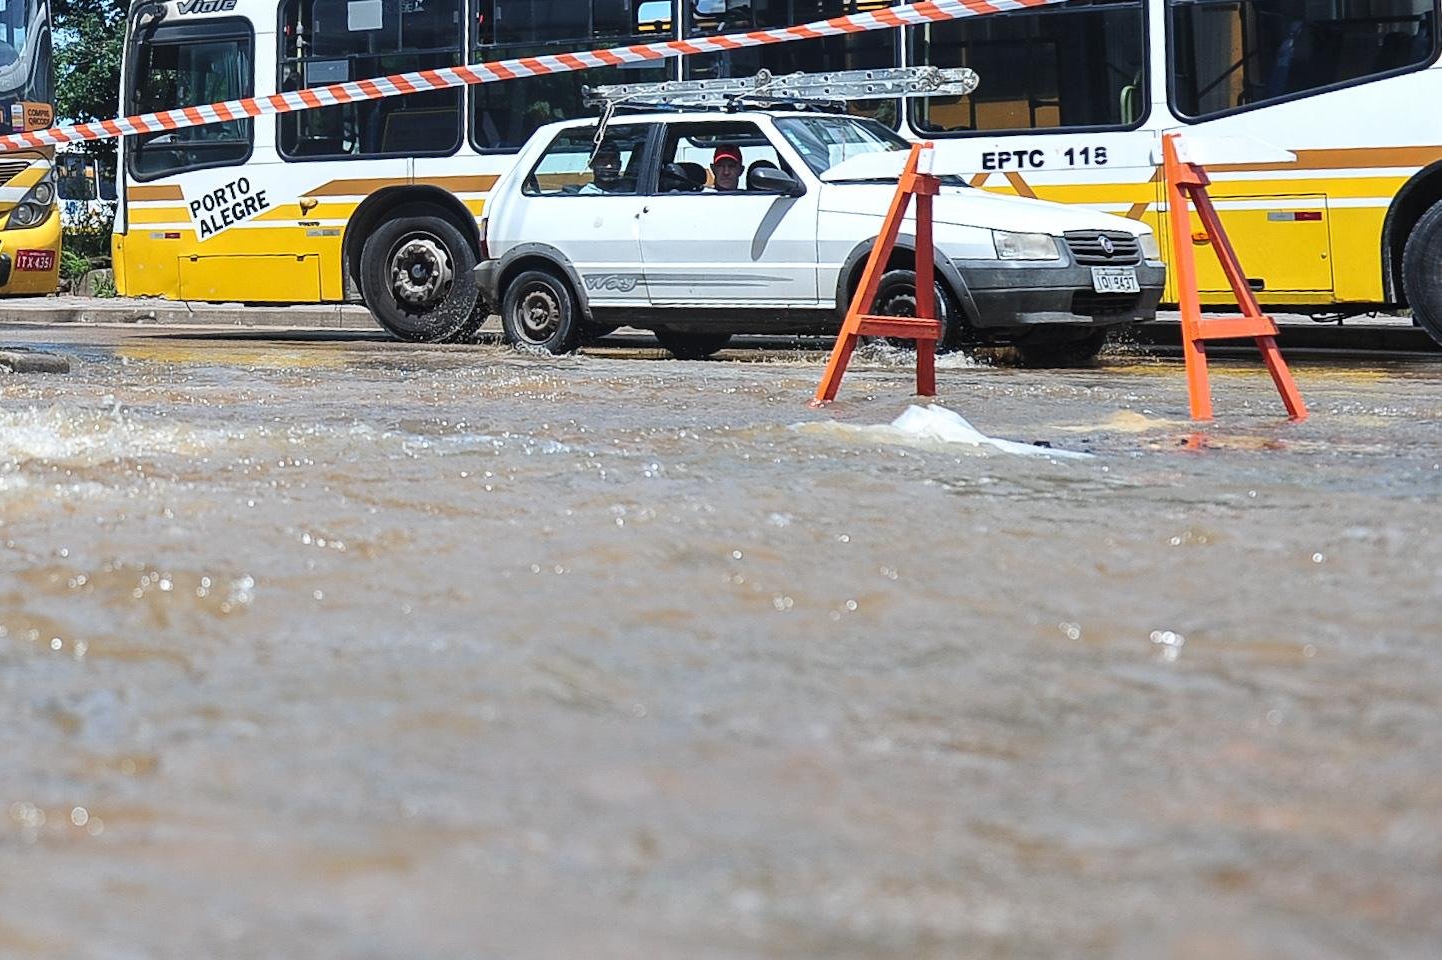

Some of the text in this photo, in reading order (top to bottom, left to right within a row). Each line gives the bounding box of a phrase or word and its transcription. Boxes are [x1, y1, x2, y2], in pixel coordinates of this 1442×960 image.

[981, 146, 1108, 170] EPTC 118
[189, 177, 251, 219] PORTO
[200, 189, 270, 239] ALEGRE
